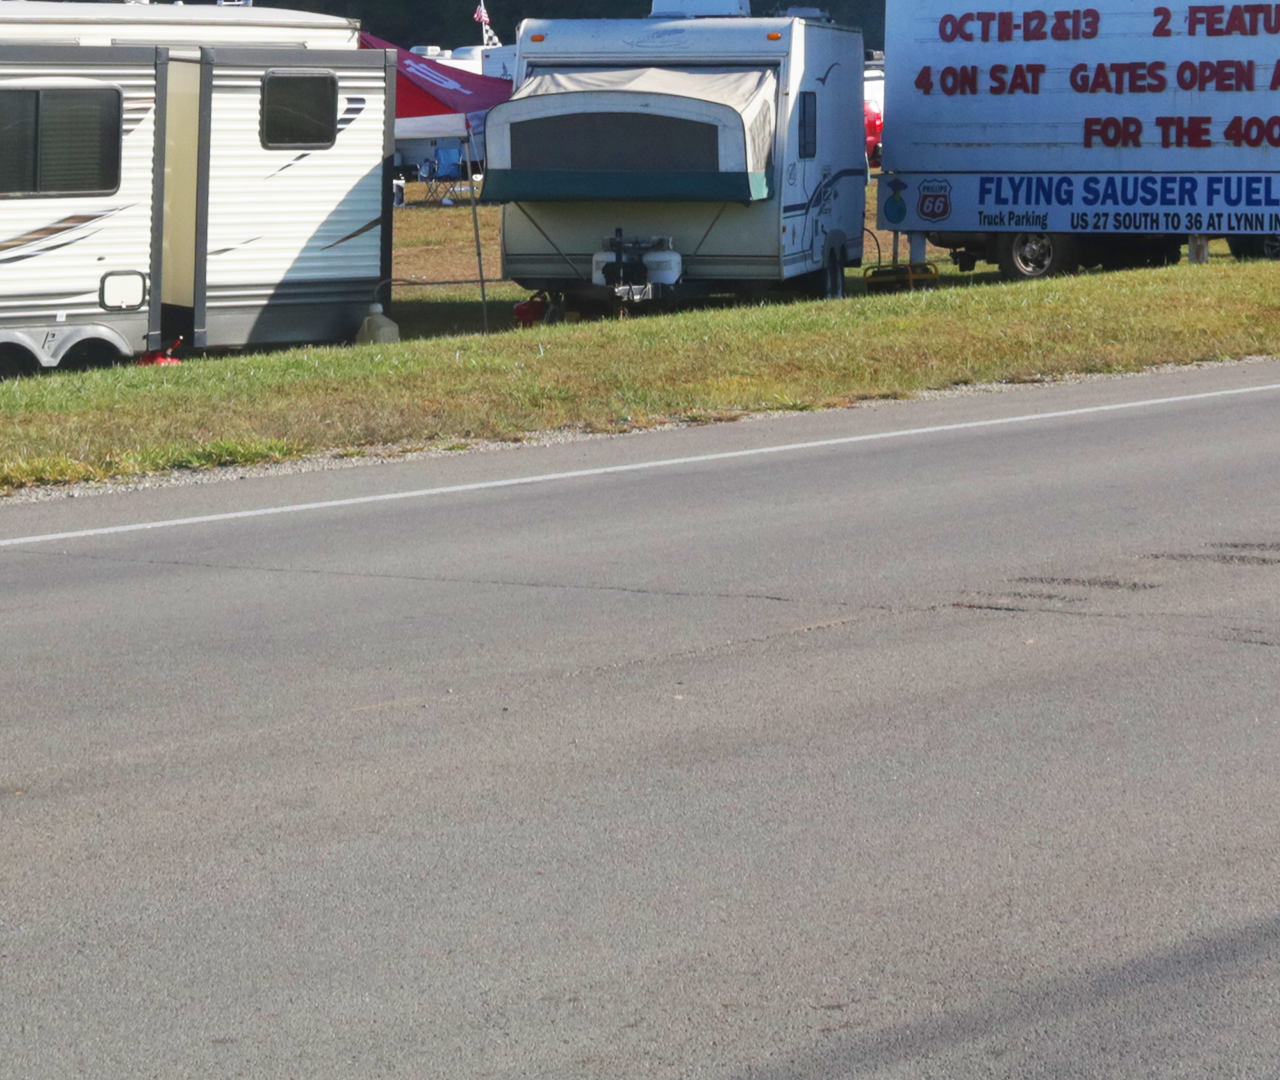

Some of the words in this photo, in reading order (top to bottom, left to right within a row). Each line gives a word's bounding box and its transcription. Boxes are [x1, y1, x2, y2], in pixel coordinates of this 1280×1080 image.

[1152, 6, 1172, 37] 2
[914, 66, 934, 95] 4
[940, 65, 978, 96] ON
[989, 64, 1046, 95] SAT
[1070, 61, 1167, 94] GATES
[1176, 60, 1255, 92] OPEN
[1083, 117, 1143, 148] FOR
[1155, 116, 1212, 148] THE
[922, 185, 948, 194] PHILLIPS
[978, 175, 1075, 207] FLYING
[1082, 175, 1198, 207] SAUSER
[1206, 176, 1280, 207] FUEL
[923, 197, 946, 214] 66
[978, 210, 1005, 226] Truck
[1008, 210, 1048, 230] Parking
[1071, 212, 1089, 230] US
[1093, 212, 1109, 230] 27
[1113, 212, 1160, 230] SOUTH
[1163, 212, 1181, 230] TO
[1185, 213, 1202, 231] 36
[1206, 213, 1223, 231] AT
[1228, 213, 1264, 231] LYNN
